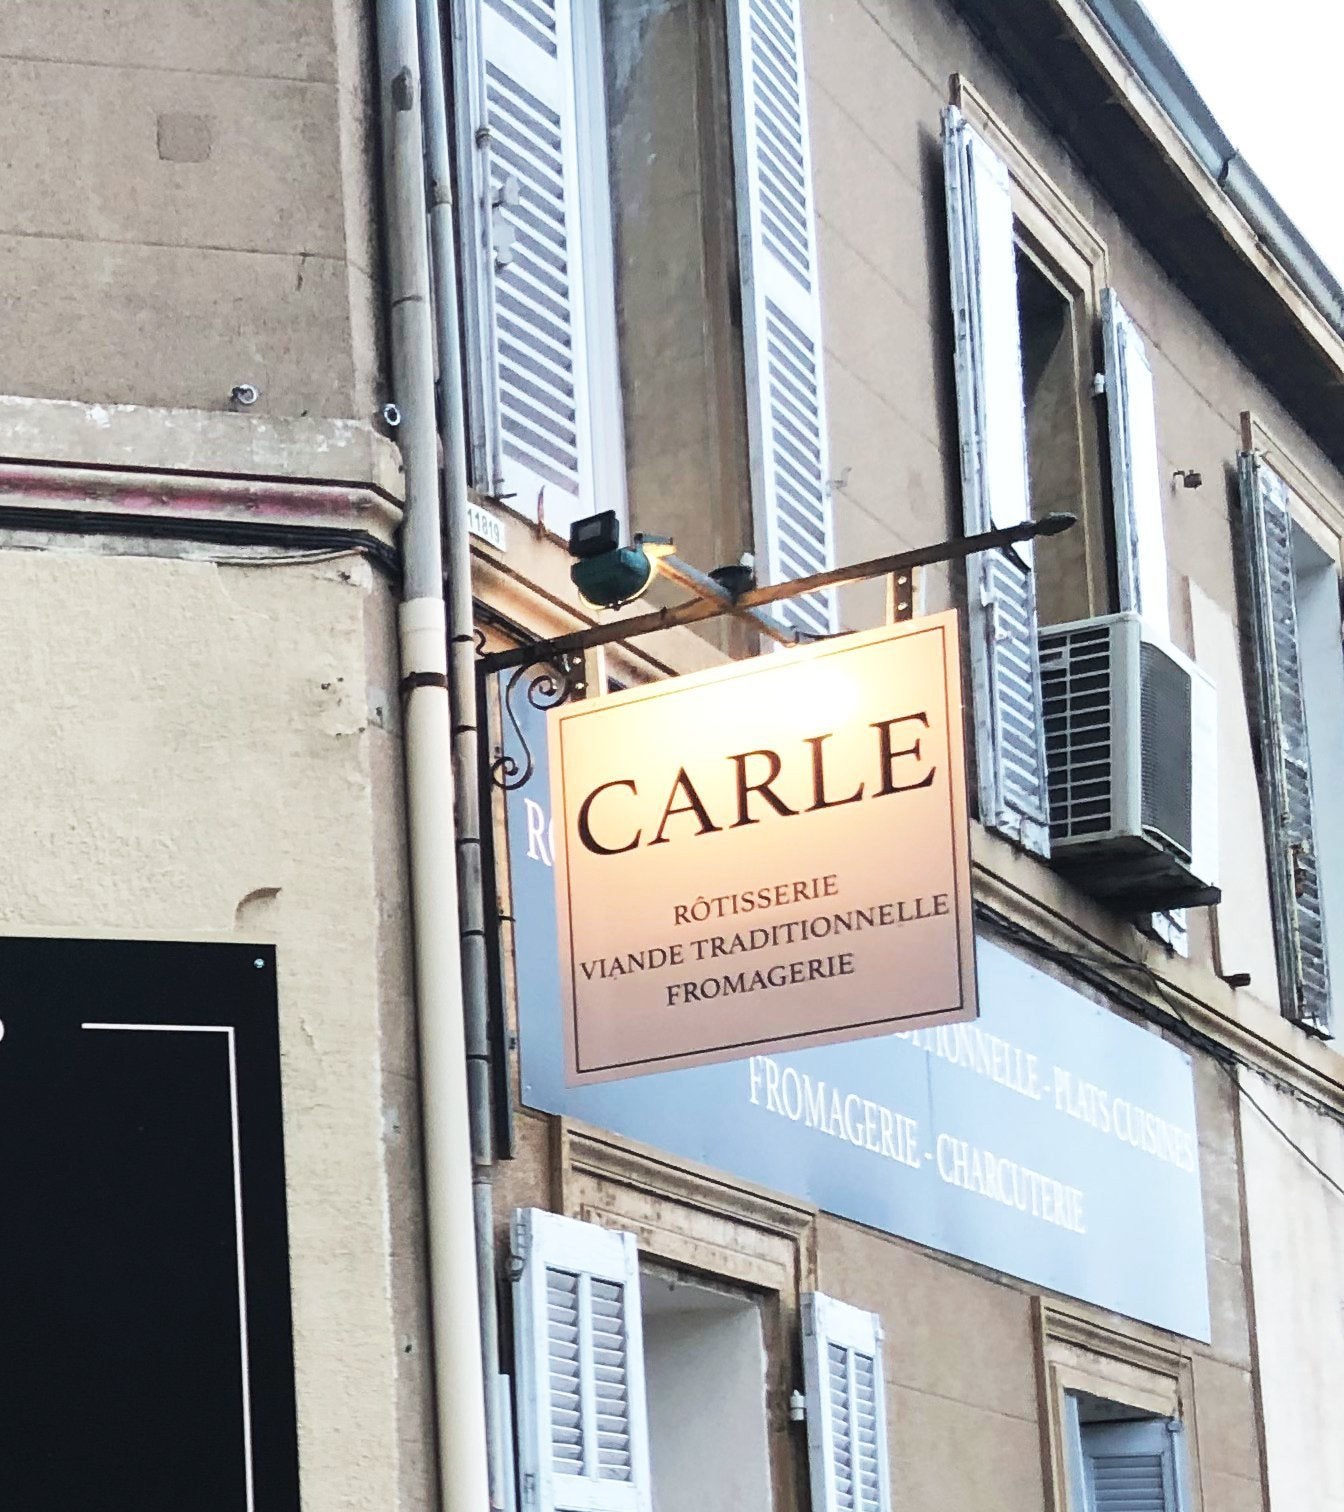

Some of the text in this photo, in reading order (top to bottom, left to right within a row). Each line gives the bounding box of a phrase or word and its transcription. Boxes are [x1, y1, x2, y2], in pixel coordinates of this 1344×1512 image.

[578, 712, 936, 855] CARLE
[579, 892, 950, 980] VIANDE TRADITIONNELLE
[674, 874, 839, 926] RÔTISSERIE
[666, 953, 855, 1007] FROMAGERIE
[1053, 1066, 1111, 1134] PLATS
[748, 1055, 921, 1169] FROMAGERIE
[936, 1133, 1086, 1234] CHARCUTERIE
